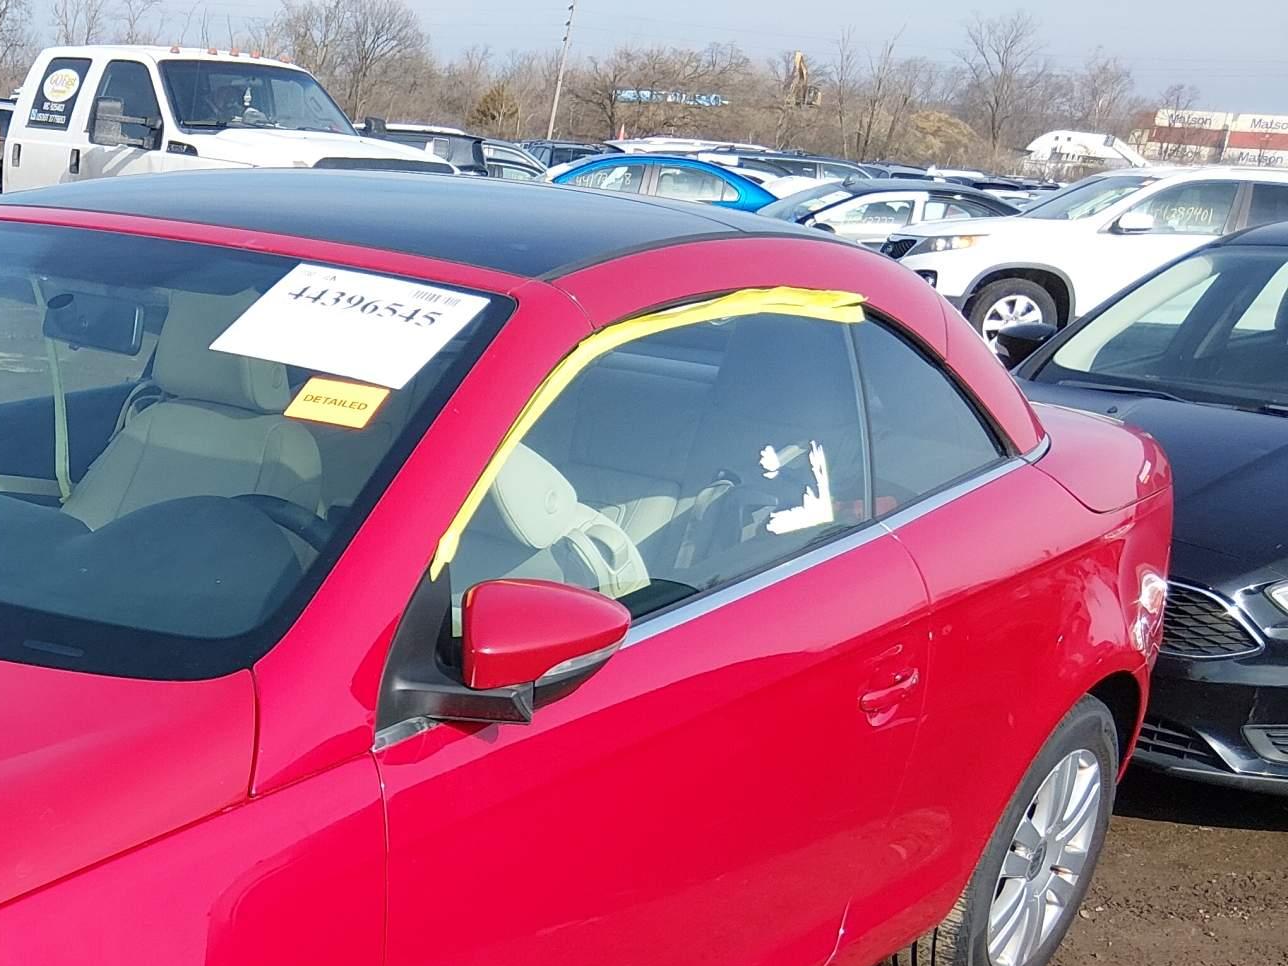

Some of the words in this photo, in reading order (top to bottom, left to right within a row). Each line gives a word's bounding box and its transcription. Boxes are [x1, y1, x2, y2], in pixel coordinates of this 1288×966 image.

[1169, 113, 1212, 127] Matson
[1238, 151, 1284, 166] Matson
[288, 285, 443, 327] 44396545
[303, 394, 368, 412] DETAILED
